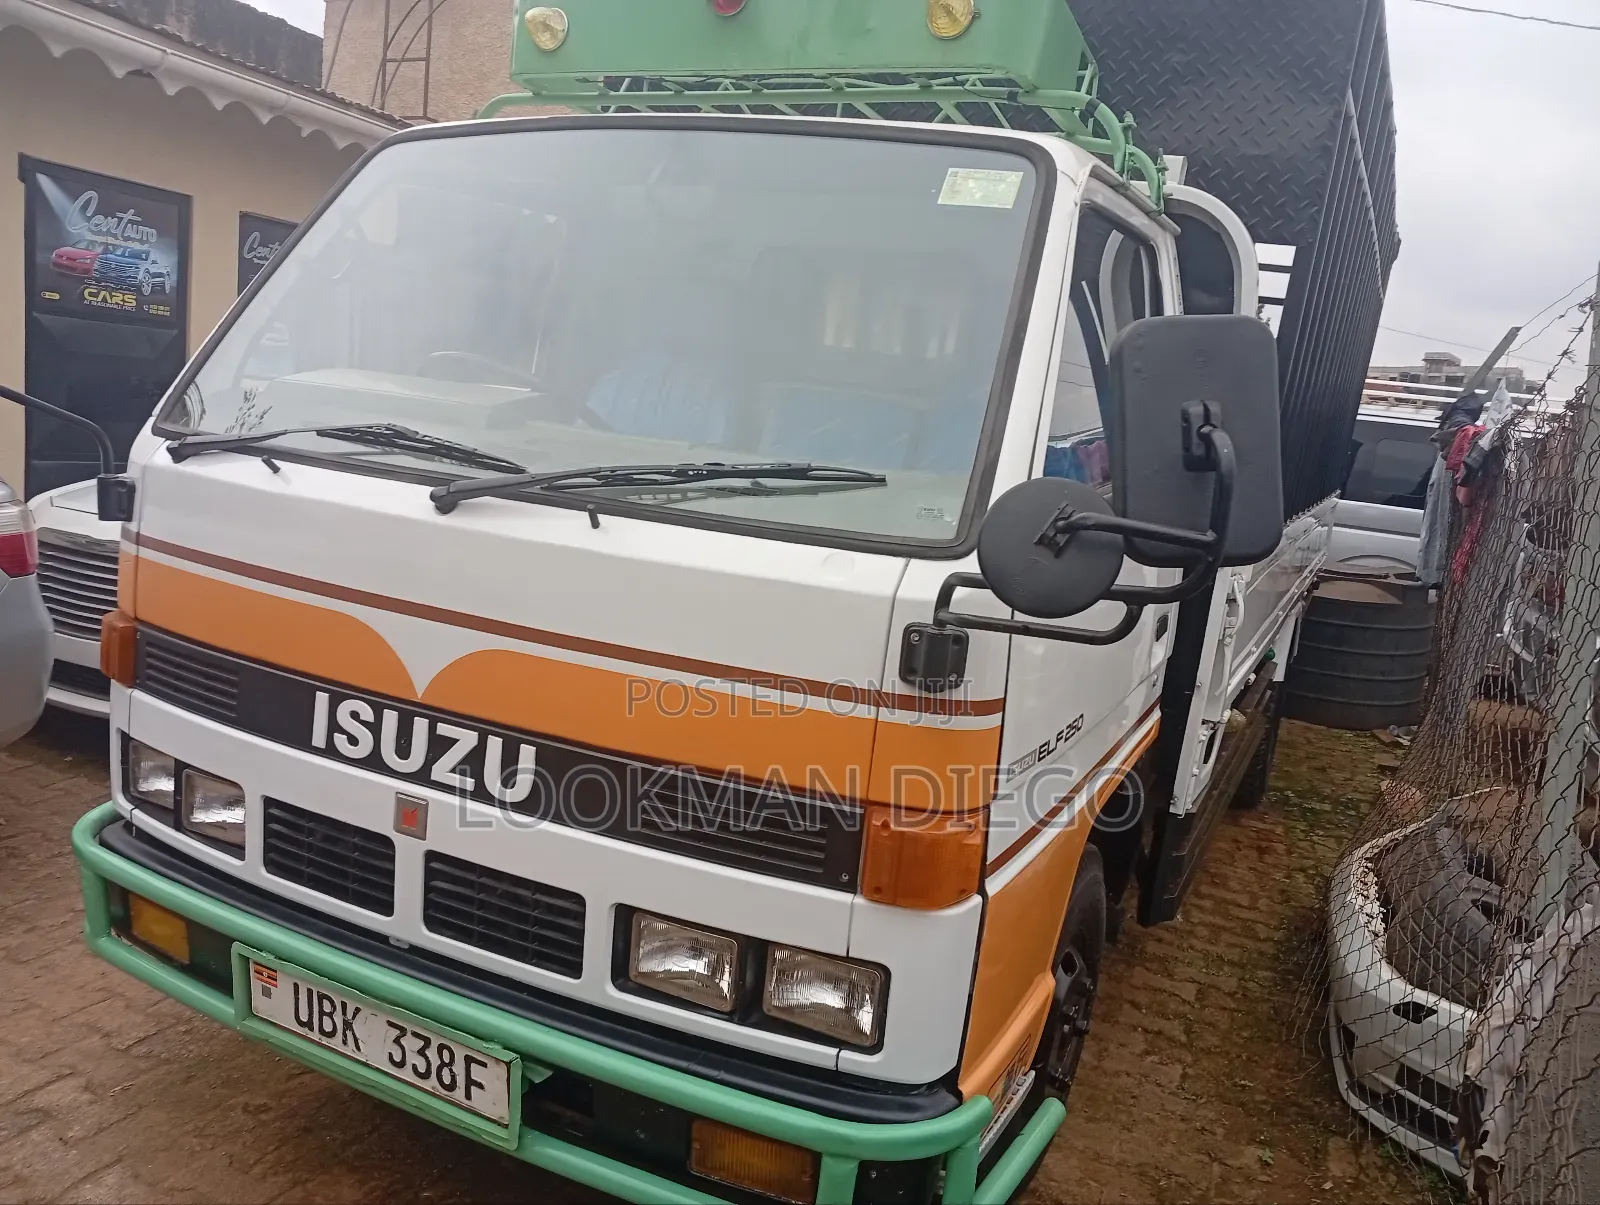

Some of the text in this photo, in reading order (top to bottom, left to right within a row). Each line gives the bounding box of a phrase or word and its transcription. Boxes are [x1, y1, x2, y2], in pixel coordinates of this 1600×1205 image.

[66, 190, 142, 240] Cent
[124, 223, 157, 242] AUTO
[83, 288, 137, 307] CARS
[312, 691, 537, 803] ISUZU
[1008, 713, 1084, 781] ISUZU ELF 250
[292, 981, 488, 1101] UBK 338F
